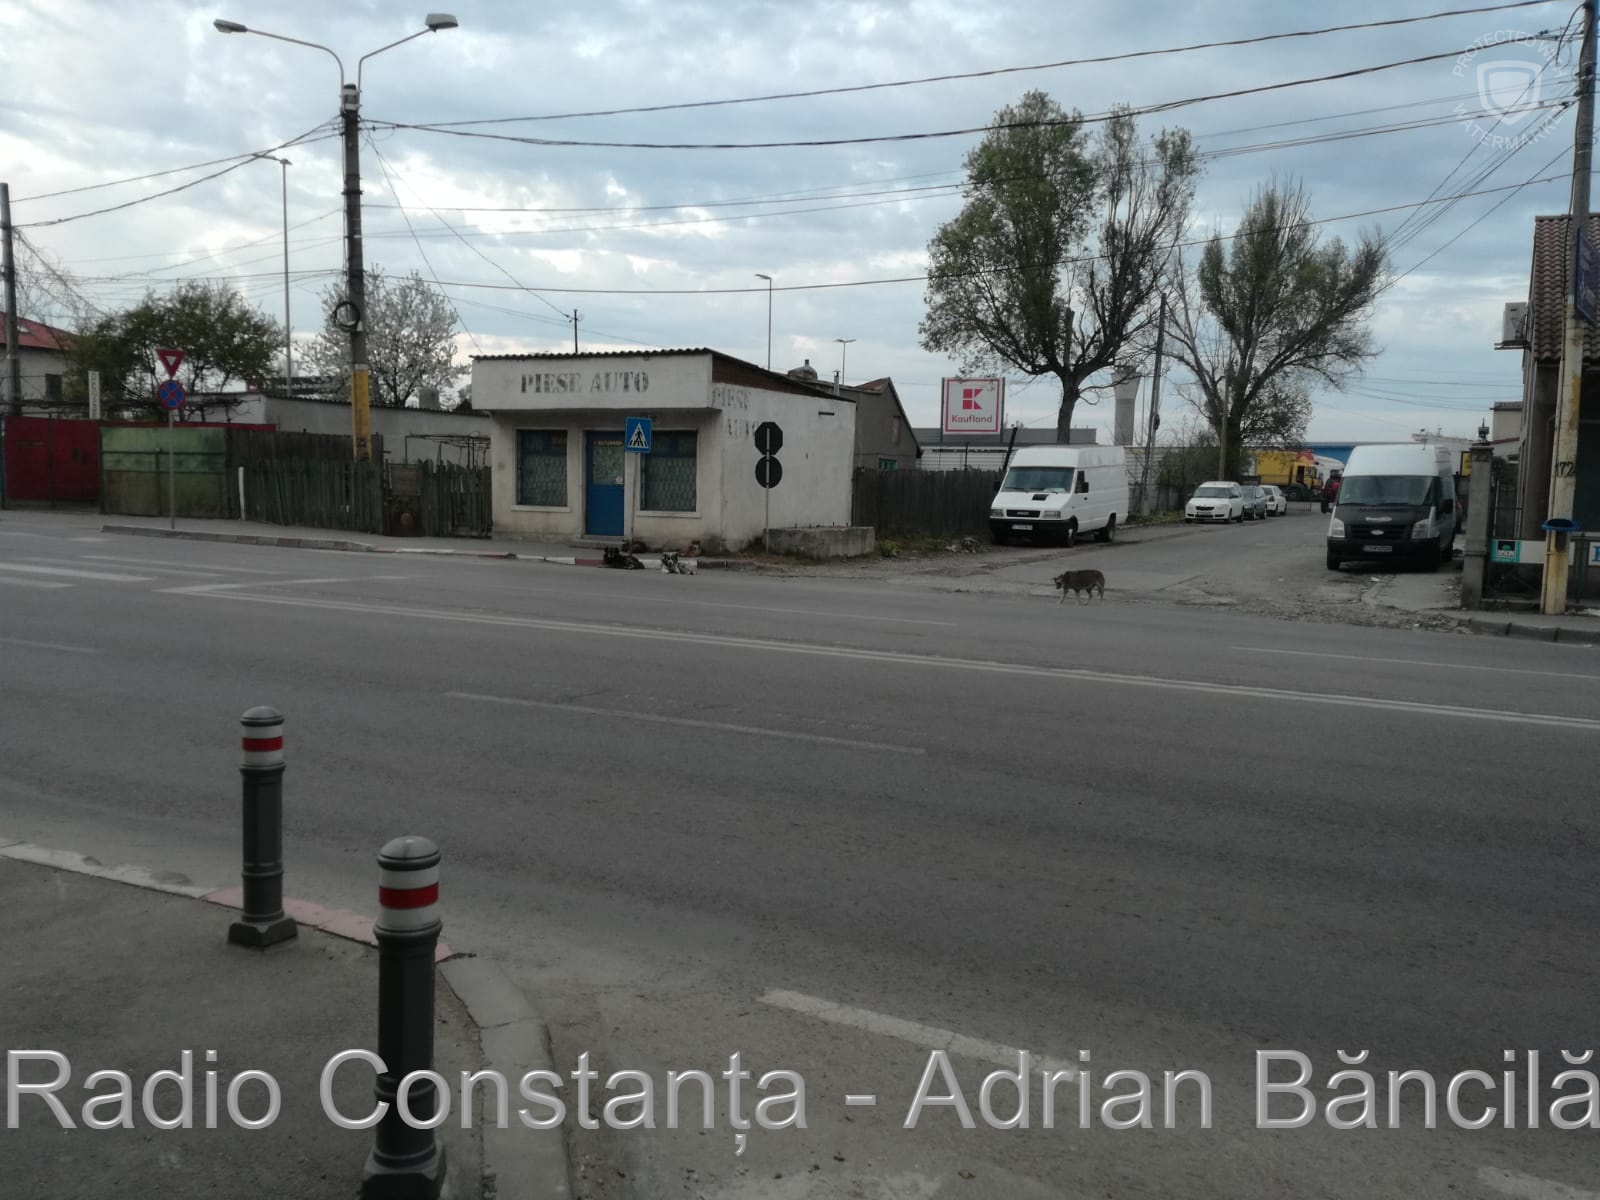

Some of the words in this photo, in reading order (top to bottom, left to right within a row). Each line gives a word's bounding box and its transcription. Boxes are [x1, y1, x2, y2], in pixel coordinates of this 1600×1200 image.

[520, 373, 582, 393] PIESE
[590, 371, 649, 393] AUTO
[951, 414, 993, 423] Kaufland
